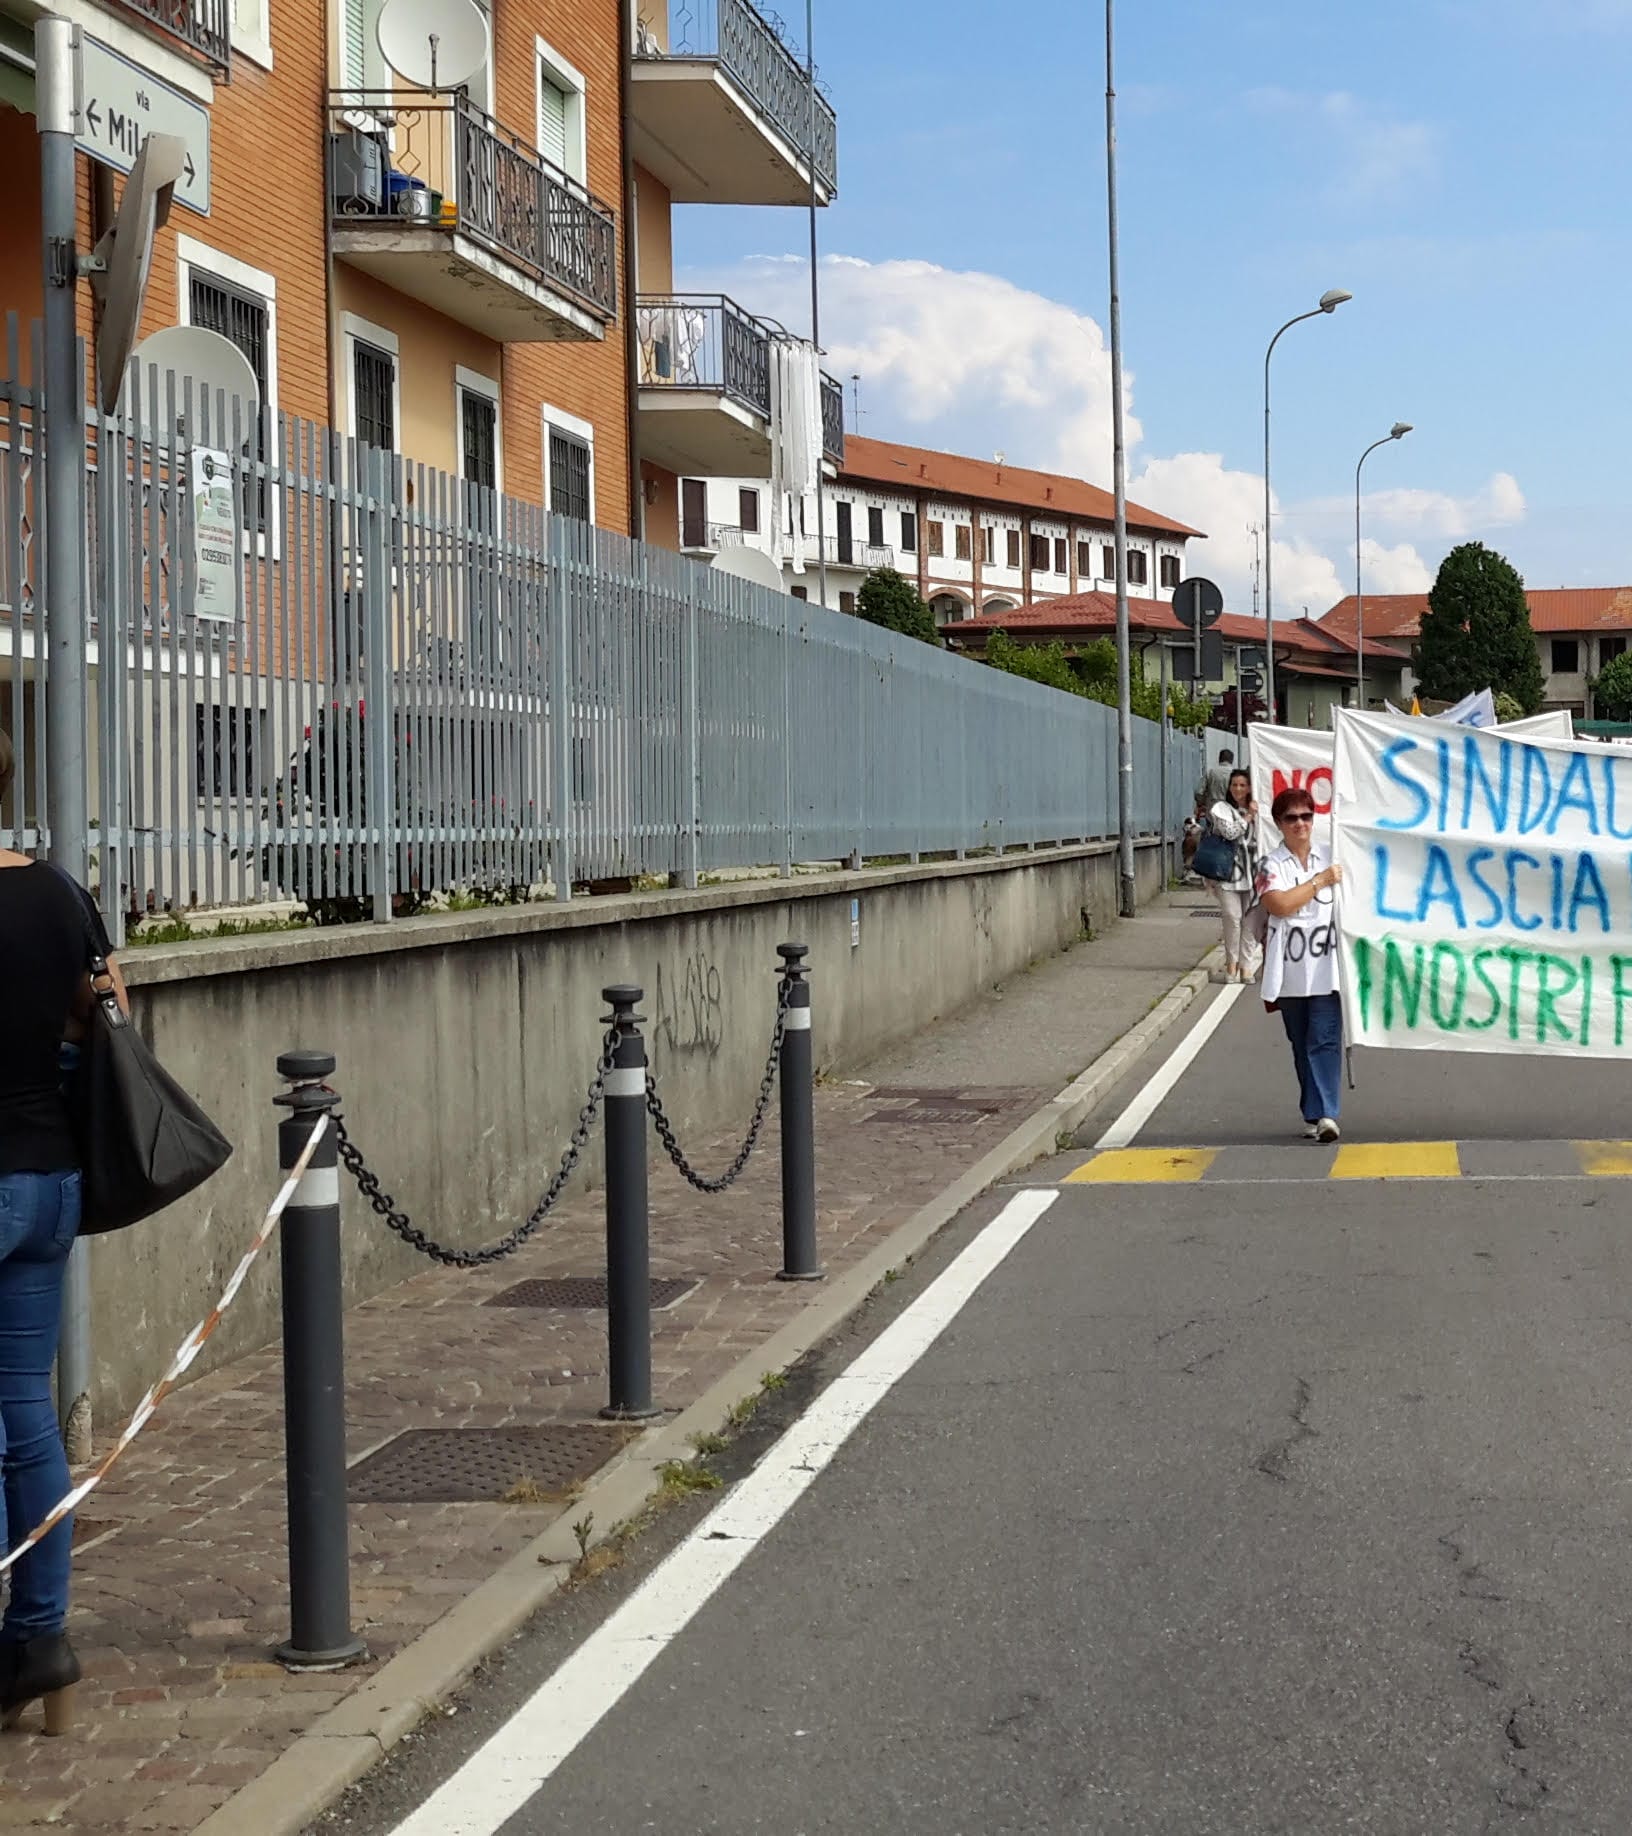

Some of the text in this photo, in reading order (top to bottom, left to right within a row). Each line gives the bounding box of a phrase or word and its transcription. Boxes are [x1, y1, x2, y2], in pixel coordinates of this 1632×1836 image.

[109, 107, 148, 160] Mil
[136, 90, 150, 111] via
[1372, 842, 1613, 935] LASCIA
[1353, 936, 1375, 1032] I
[1381, 936, 1594, 1047] NOSTRI
